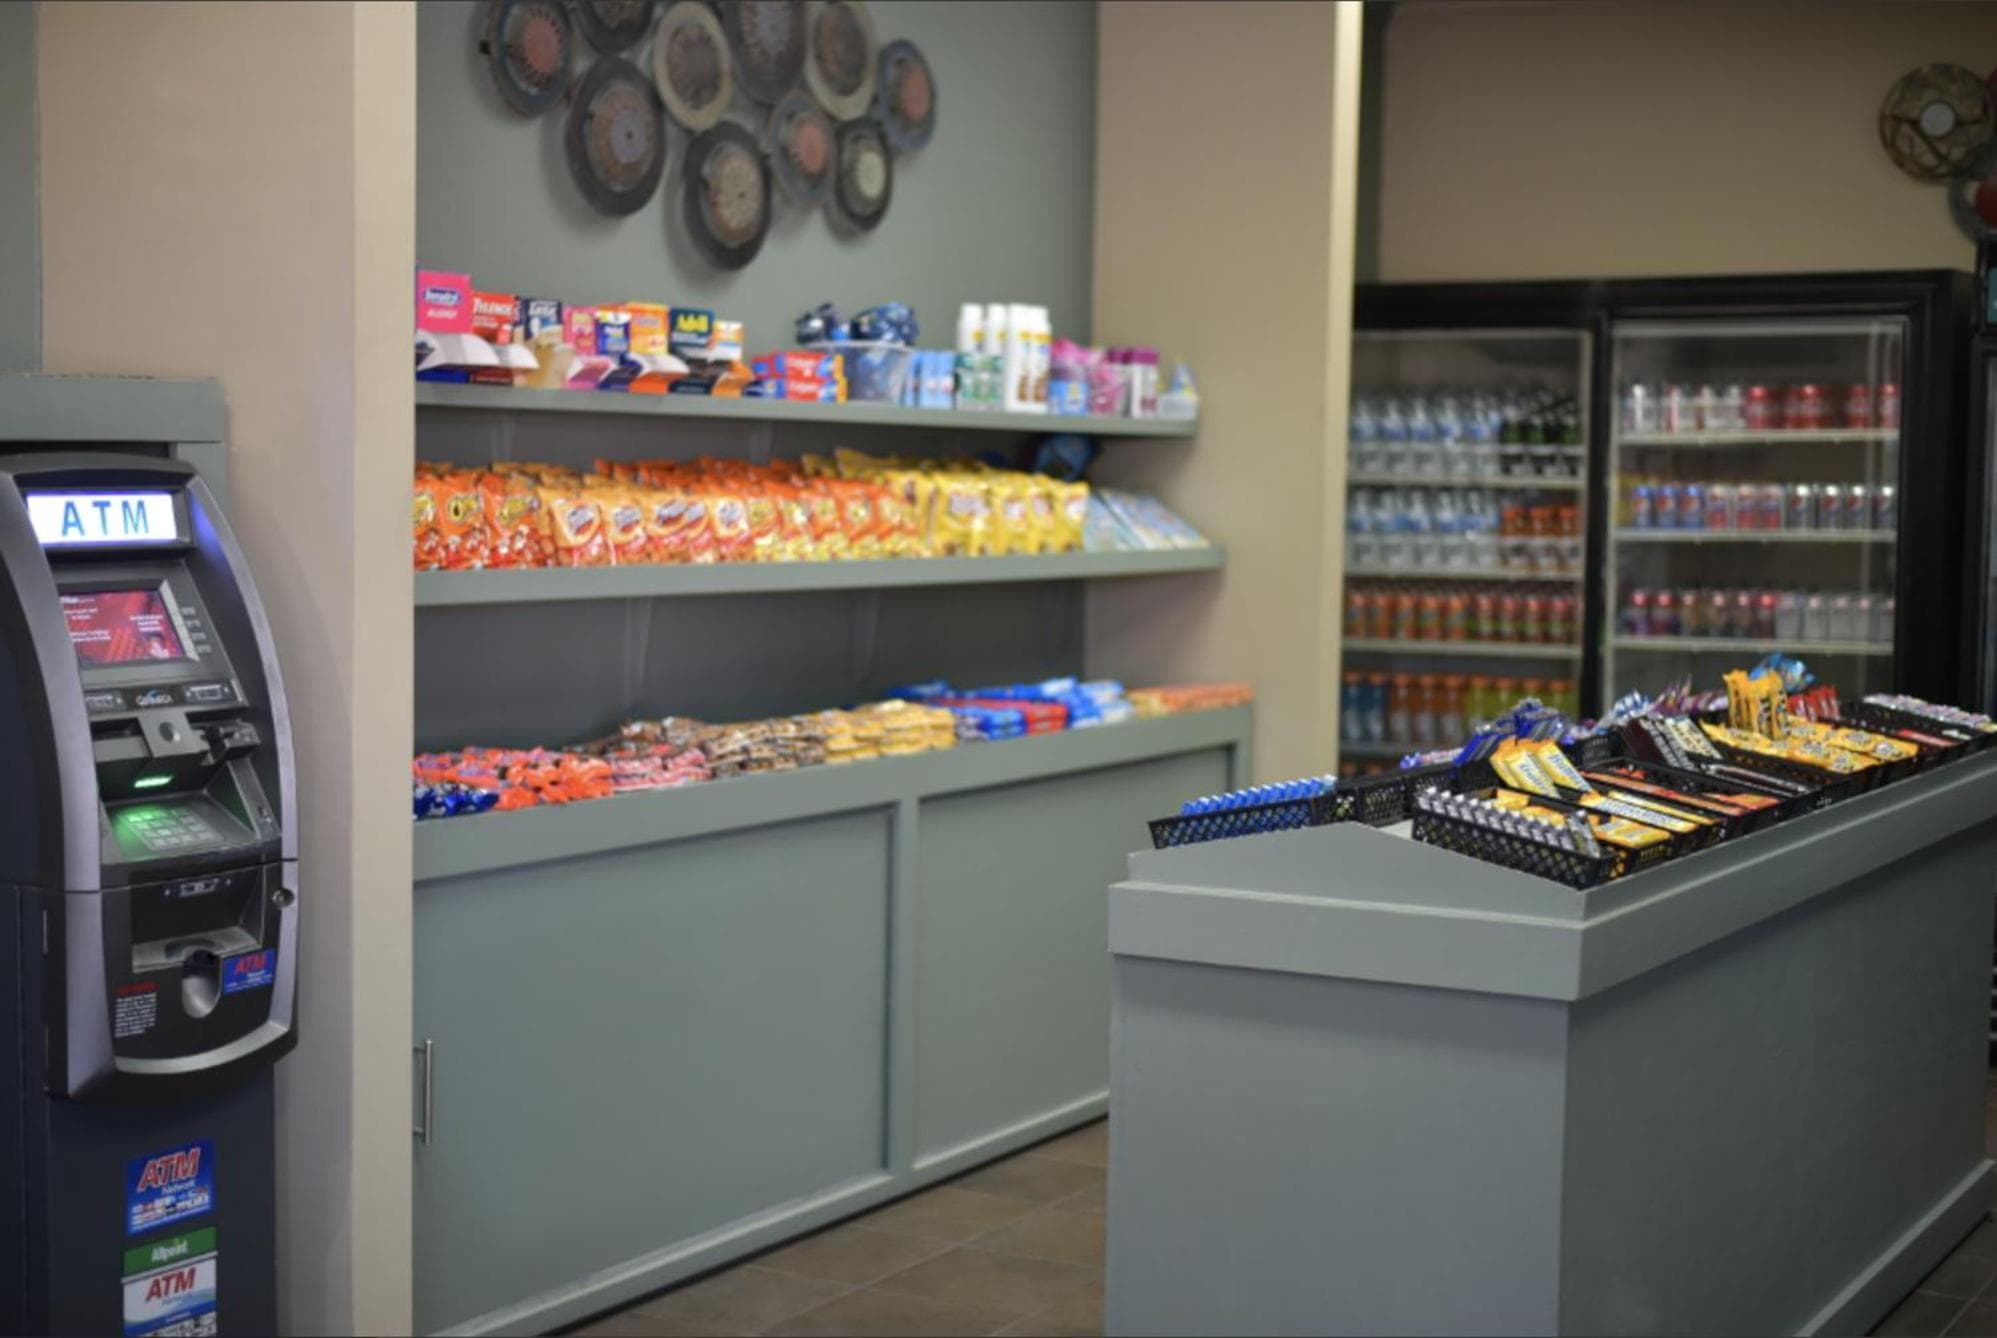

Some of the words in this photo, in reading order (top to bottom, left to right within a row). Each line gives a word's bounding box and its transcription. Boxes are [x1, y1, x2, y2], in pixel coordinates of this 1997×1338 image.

[61, 499, 149, 537] ATM
[136, 1147, 201, 1193] ATM
[145, 1266, 197, 1302] ATM
